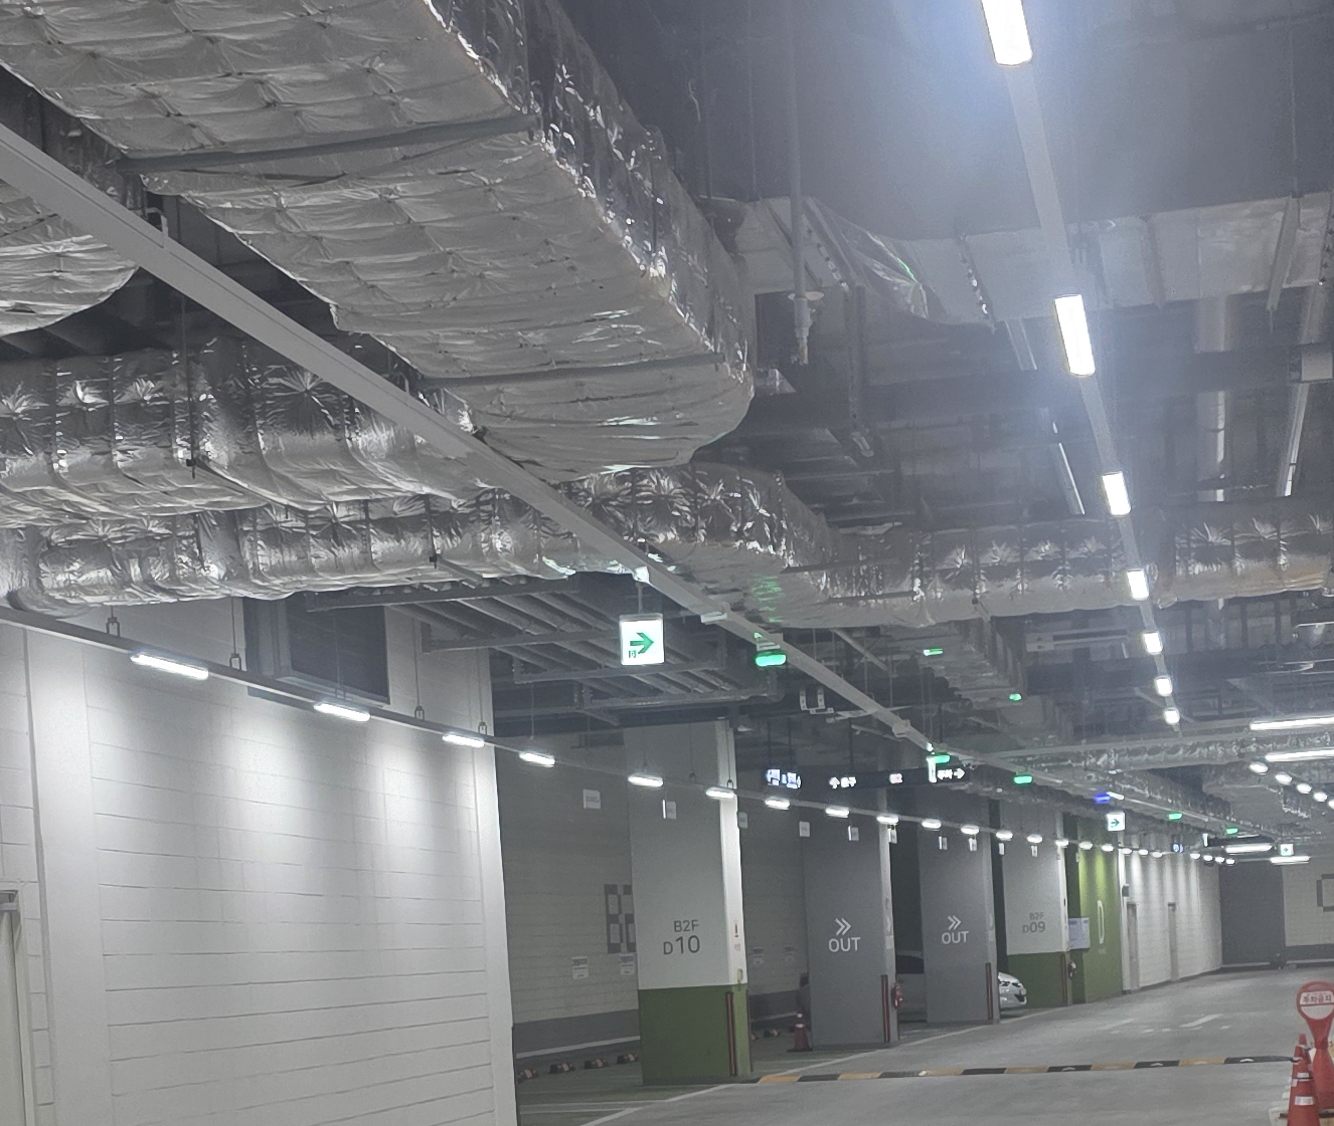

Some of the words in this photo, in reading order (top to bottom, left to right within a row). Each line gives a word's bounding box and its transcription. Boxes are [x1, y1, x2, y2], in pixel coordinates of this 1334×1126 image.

[1029, 911, 1046, 920] B2F
[673, 919, 699, 933] B2F
[1021, 920, 1046, 934] D09
[828, 936, 862, 953] OUT
[940, 930, 970, 945] OUT
[663, 935, 701, 955] D10
